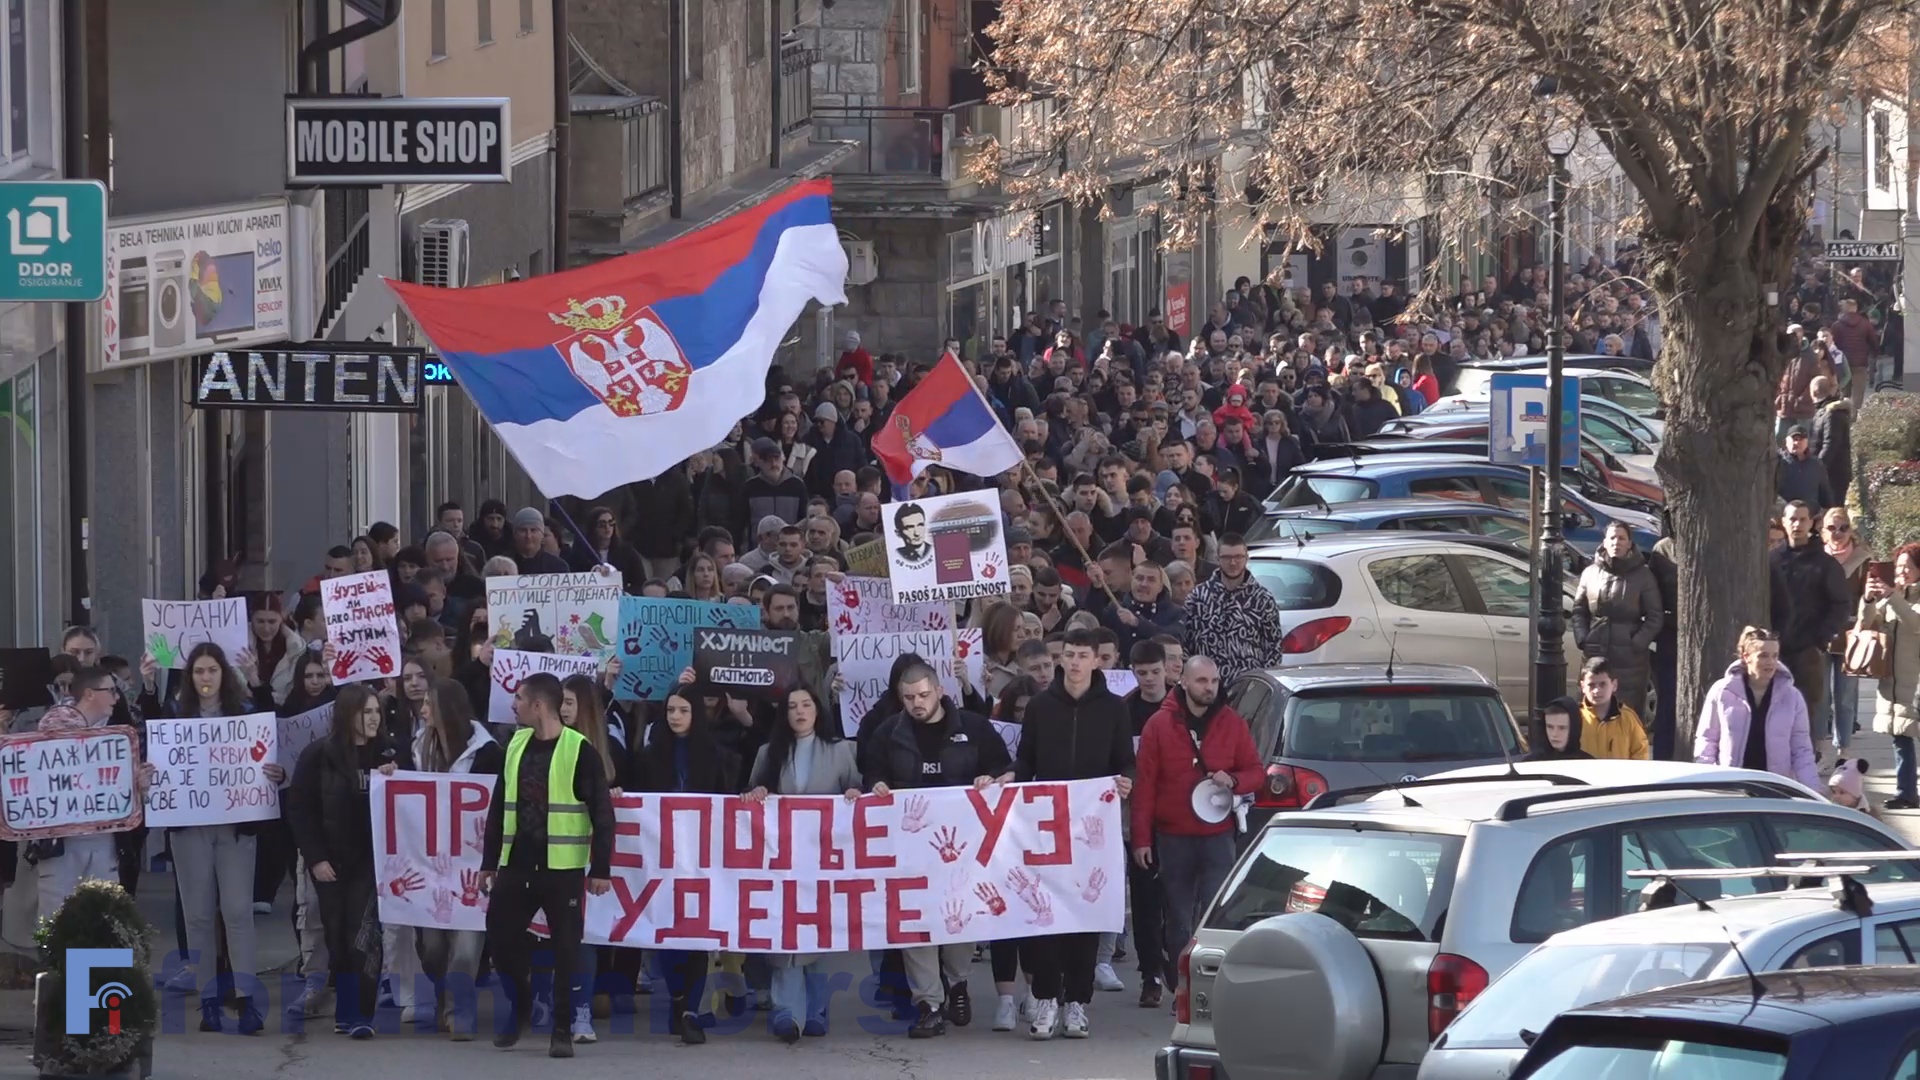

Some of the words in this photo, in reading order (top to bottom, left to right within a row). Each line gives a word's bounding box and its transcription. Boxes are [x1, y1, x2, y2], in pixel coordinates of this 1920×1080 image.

[298, 120, 408, 163] MOBILE
[416, 120, 497, 163] SHOP
[120, 231, 143, 248] BELA
[146, 226, 185, 244] TEHNIKA
[187, 226, 191, 240] I
[194, 222, 213, 238] MALI
[245, 214, 282, 231] APARATI
[257, 237, 282, 257] beko
[1829, 243, 1898, 257] ADVOKAT
[18, 262, 73, 277] DDOR
[19, 278, 83, 287] OSIGURANJE
[259, 276, 282, 291] VIVAX
[257, 301, 283, 313] SENCOR
[199, 352, 417, 403] ANTEN
[517, 573, 597, 589] СТОПАМА
[899, 585, 930, 604] PASOŠ
[931, 588, 945, 600] ZA
[946, 580, 1007, 599] BUDUĆNOST
[558, 587, 619, 606] СТУДЕНАТА
[152, 600, 238, 629] УСТАНИ
[352, 602, 395, 621] ГЛАСНО
[641, 604, 701, 626] ОДРАСЛИ
[700, 631, 794, 655] ХУМАНОСТ
[840, 632, 945, 662] ИСКЉУЧИ
[513, 652, 531, 671] ЈА
[539, 655, 599, 675] ПРИПАДАМ
[638, 655, 676, 676] ДЕЦИ
[711, 668, 773, 682] ЛАЈТМОТИВ
[150, 723, 169, 745] НЕ
[174, 723, 193, 744] БИ
[2, 750, 26, 775] НЕ
[37, 738, 127, 771] ЛАЖИТЕ
[168, 746, 199, 766] ОВЕ
[209, 747, 248, 765] КРВИ
[150, 769, 171, 788] ДА
[180, 769, 195, 786] ЈЕ
[209, 766, 256, 787] БИЛО
[7, 796, 58, 822] БАБУ
[67, 797, 78, 812] И
[84, 789, 131, 815] ДЕДУ
[150, 789, 178, 811] СВЕ
[189, 790, 210, 809] ПО
[224, 784, 278, 811] ЗАКОНУ
[964, 784, 1073, 868] УЗ
